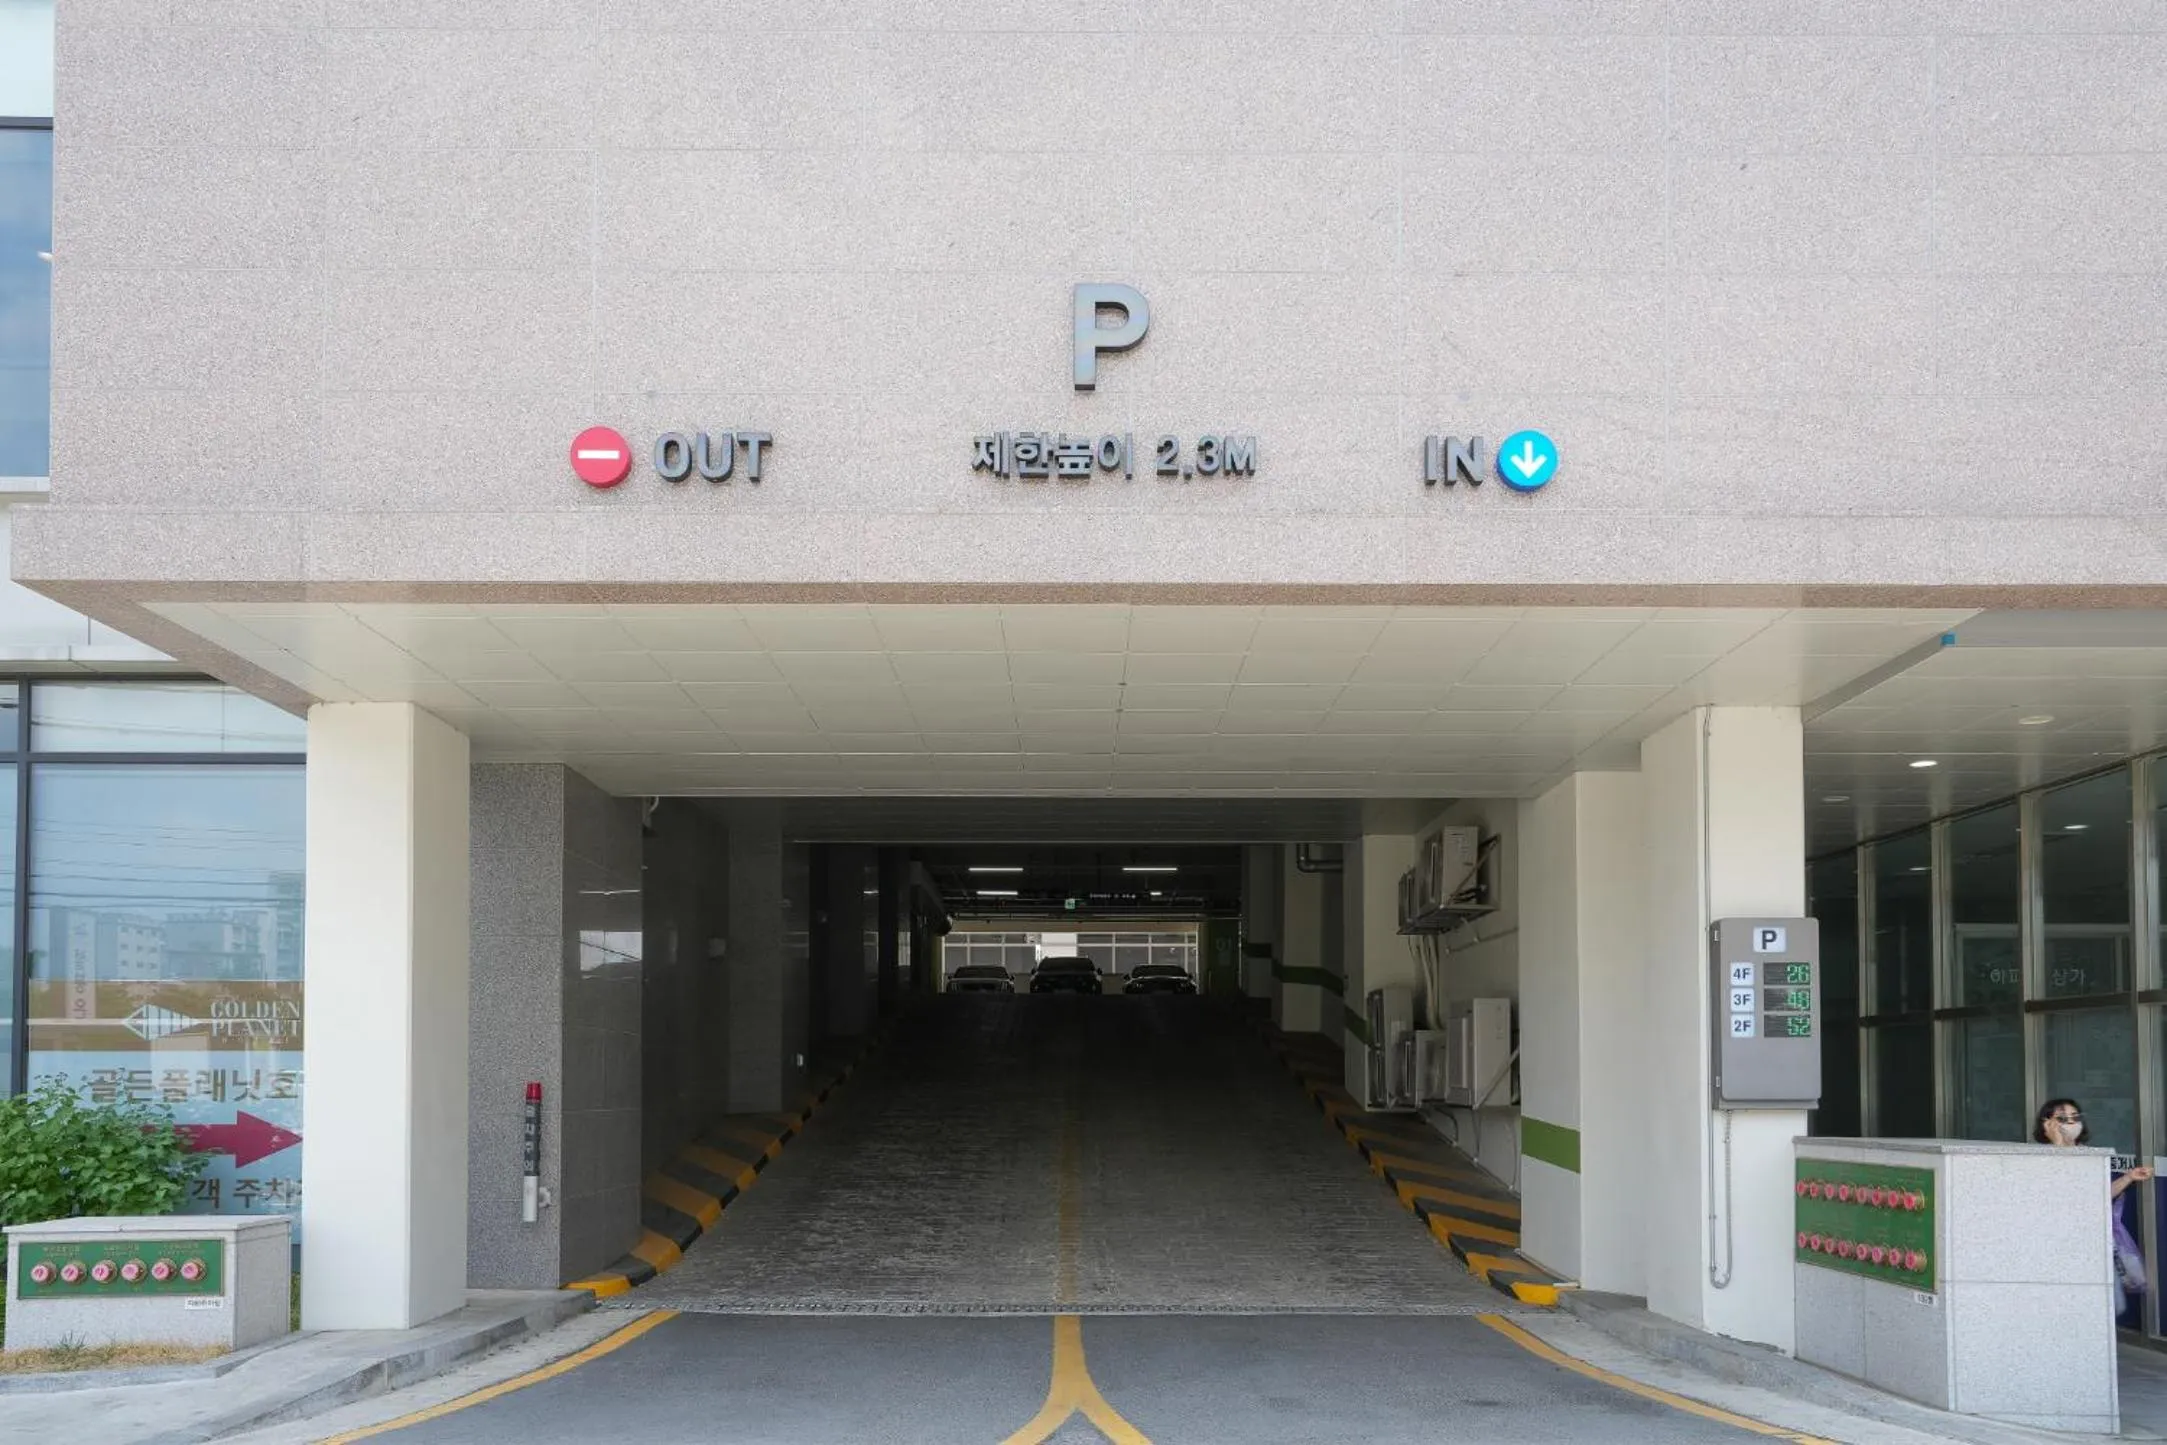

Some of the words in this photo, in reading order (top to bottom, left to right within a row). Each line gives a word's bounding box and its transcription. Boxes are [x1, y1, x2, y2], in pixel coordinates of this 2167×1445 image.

[1073, 282, 1150, 392] P
[654, 430, 773, 483] OUT
[971, 431, 1134, 480] 제한높이
[1155, 433, 1257, 481] 2.3M
[1424, 435, 1485, 487] IN
[1761, 929, 1778, 951] P
[1733, 967, 1751, 980] 4F
[210, 1001, 300, 1019] GOLDEN
[1733, 993, 1751, 1006] 3F
[211, 1019, 300, 1037] PLANET
[1734, 1019, 1752, 1033] 2F
[90, 1068, 303, 1104] 골든플래닛호
[232, 1177, 302, 1209] 주차
